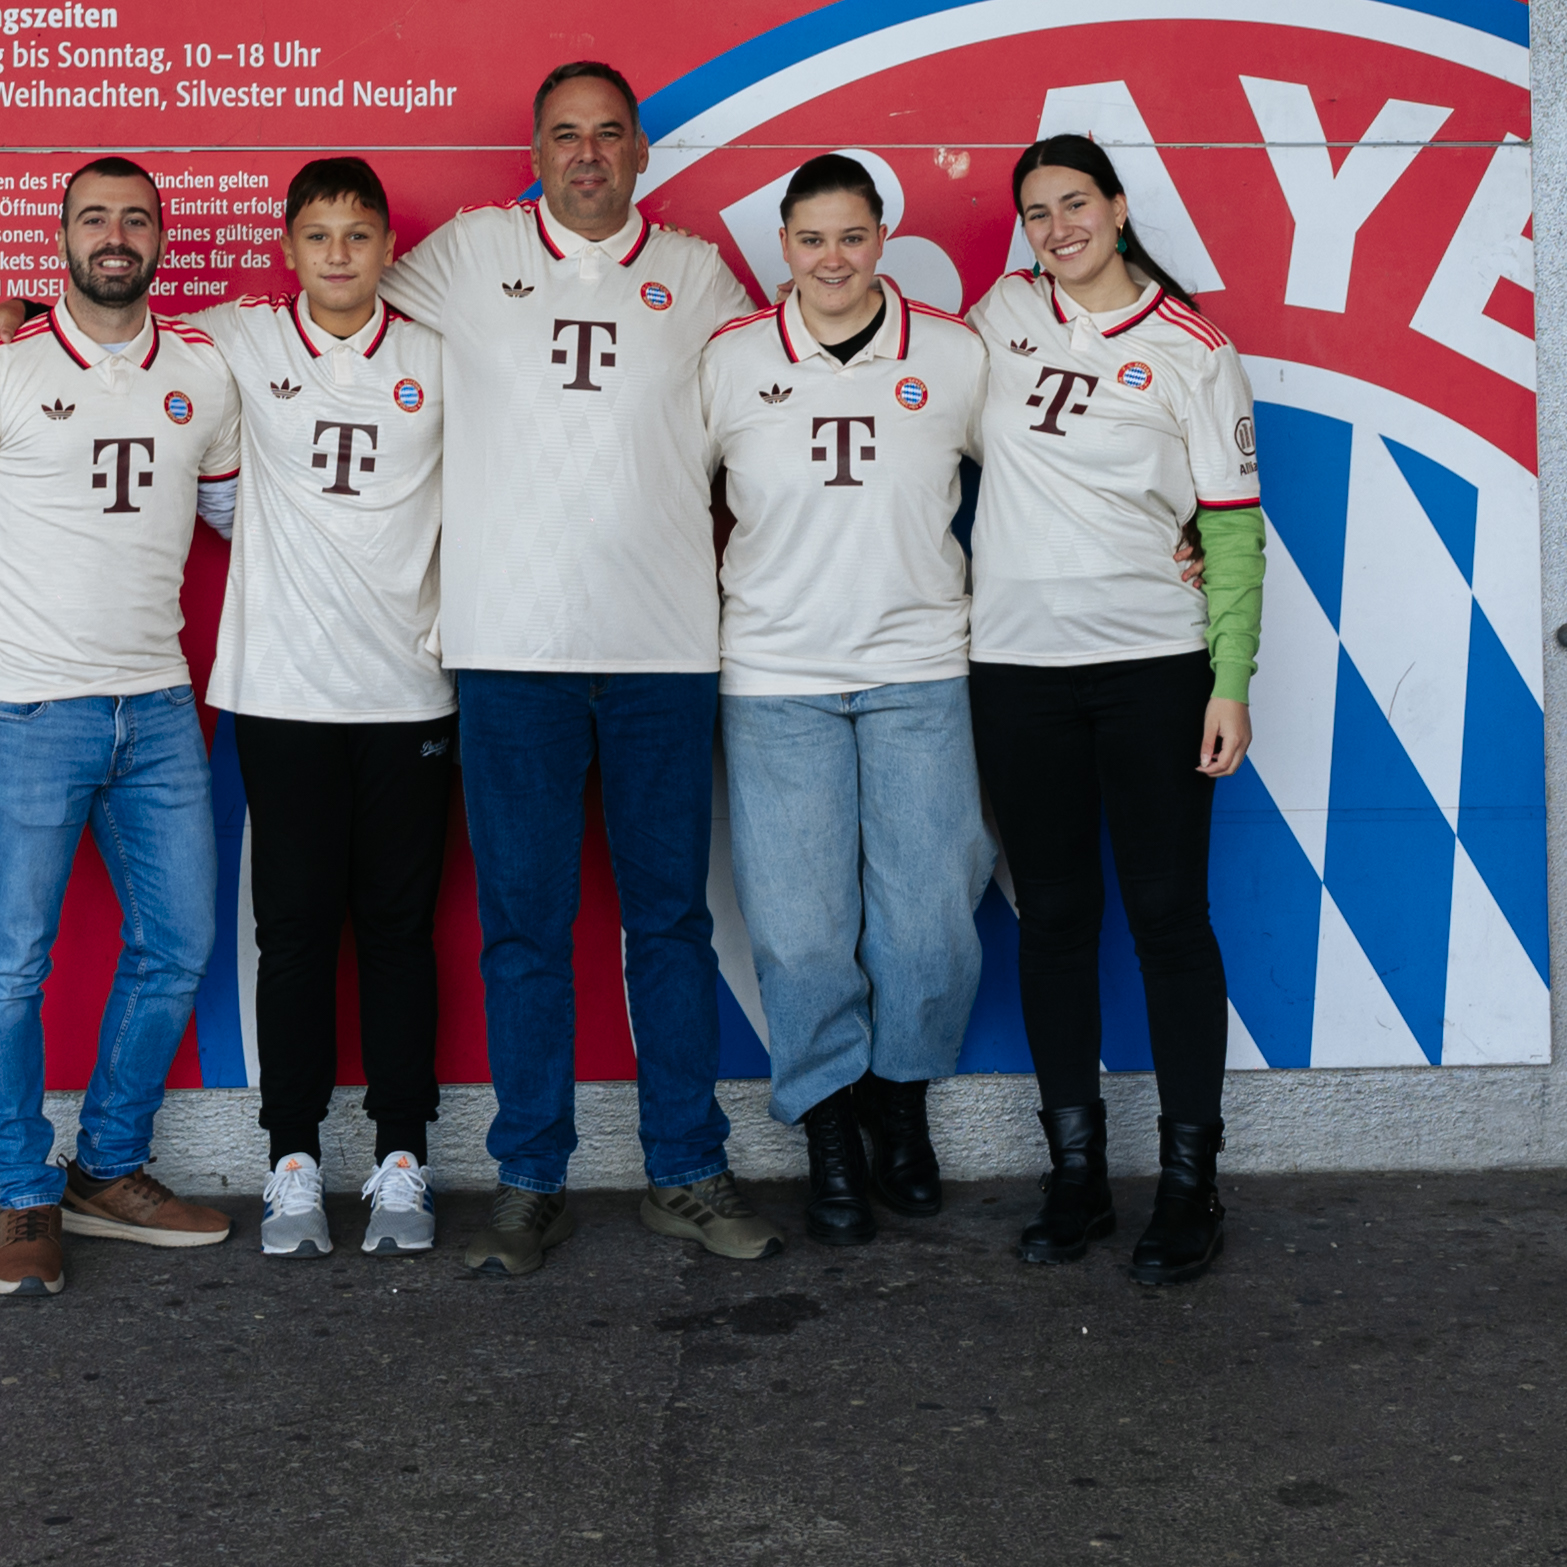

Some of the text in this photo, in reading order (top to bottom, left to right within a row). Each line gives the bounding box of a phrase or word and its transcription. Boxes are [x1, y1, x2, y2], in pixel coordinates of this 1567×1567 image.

[12, 40, 50, 68] bis
[57, 41, 173, 75] Sonntag,
[273, 39, 322, 68] Uhr
[176, 79, 287, 108] Silvester
[294, 79, 344, 107] und
[353, 79, 458, 114] Neujahr
[19, 171, 48, 190] des
[149, 171, 215, 189] ünchen
[218, 170, 269, 193] gelten
[170, 197, 229, 216] Eintritt
[233, 197, 288, 219] erfolgt
[167, 223, 211, 242] eines
[215, 223, 284, 245] gültigen
[157, 249, 206, 269] ckets
[210, 249, 236, 268] für
[240, 249, 271, 268] das
[182, 276, 229, 296] einer
